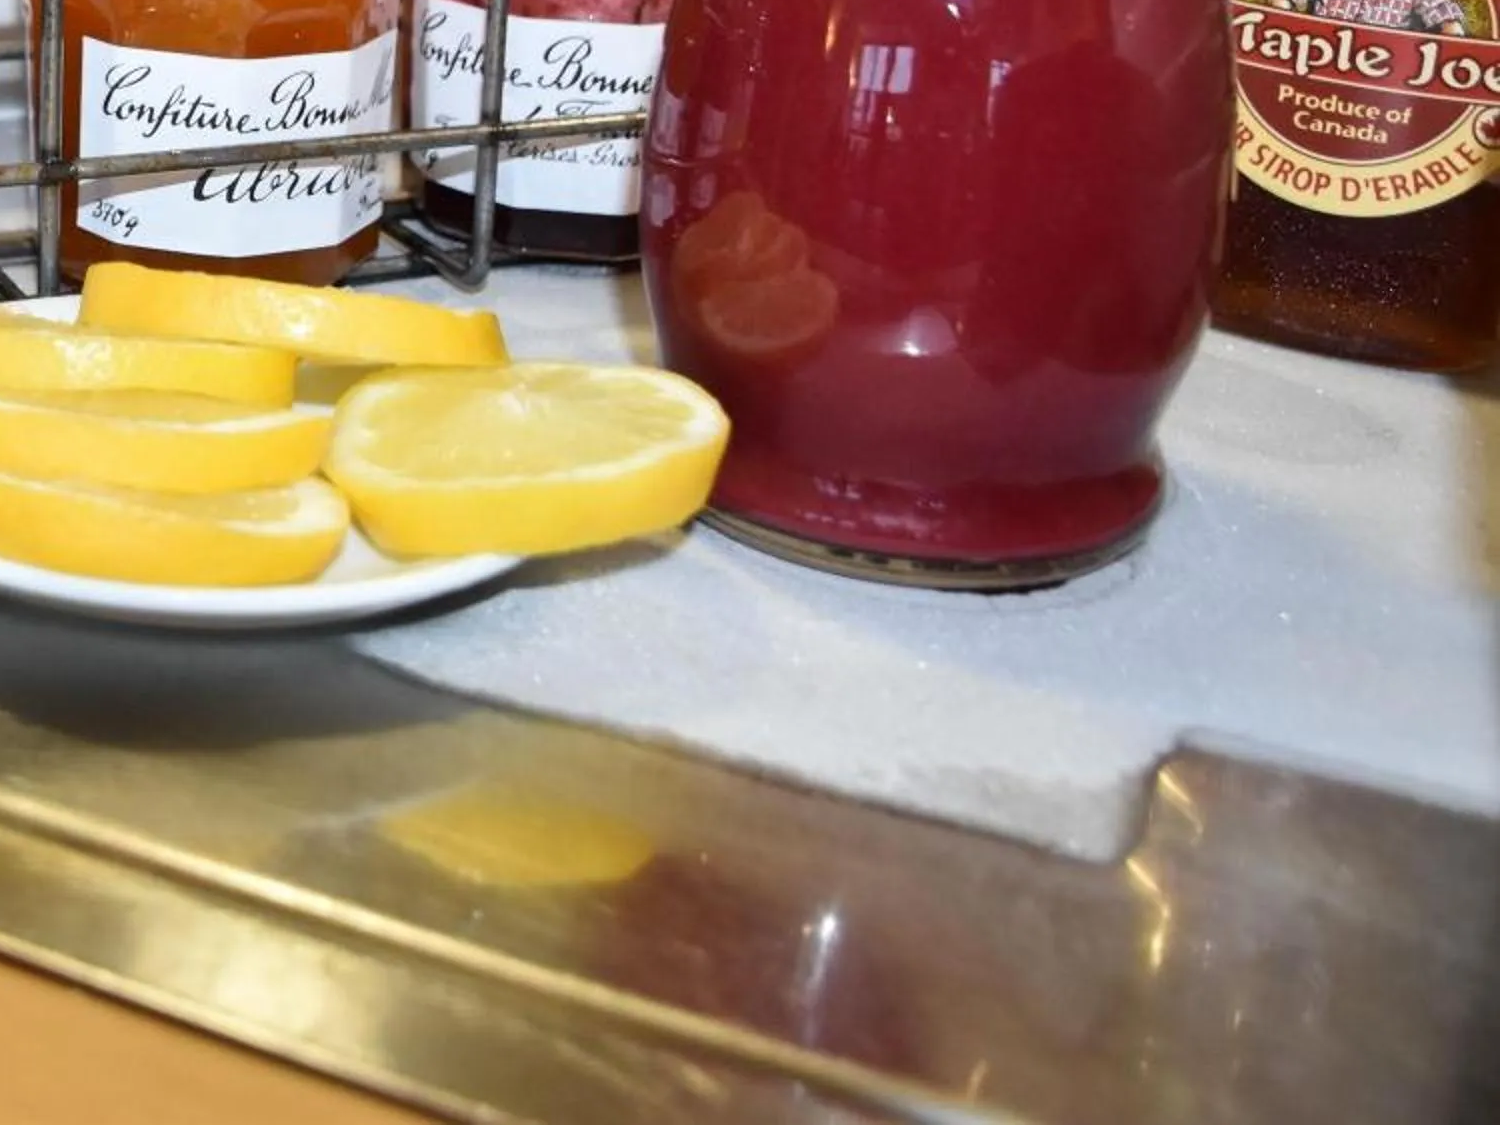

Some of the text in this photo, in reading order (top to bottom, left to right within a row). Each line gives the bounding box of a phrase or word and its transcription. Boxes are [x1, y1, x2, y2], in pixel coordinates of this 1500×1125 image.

[538, 36, 652, 95] Bonne
[102, 65, 258, 137] Confiture
[1278, 83, 1412, 125] Produce of
[1293, 112, 1389, 145] Canada
[1249, 138, 1332, 202] SIROP
[1340, 141, 1484, 203] D'ERABLE
